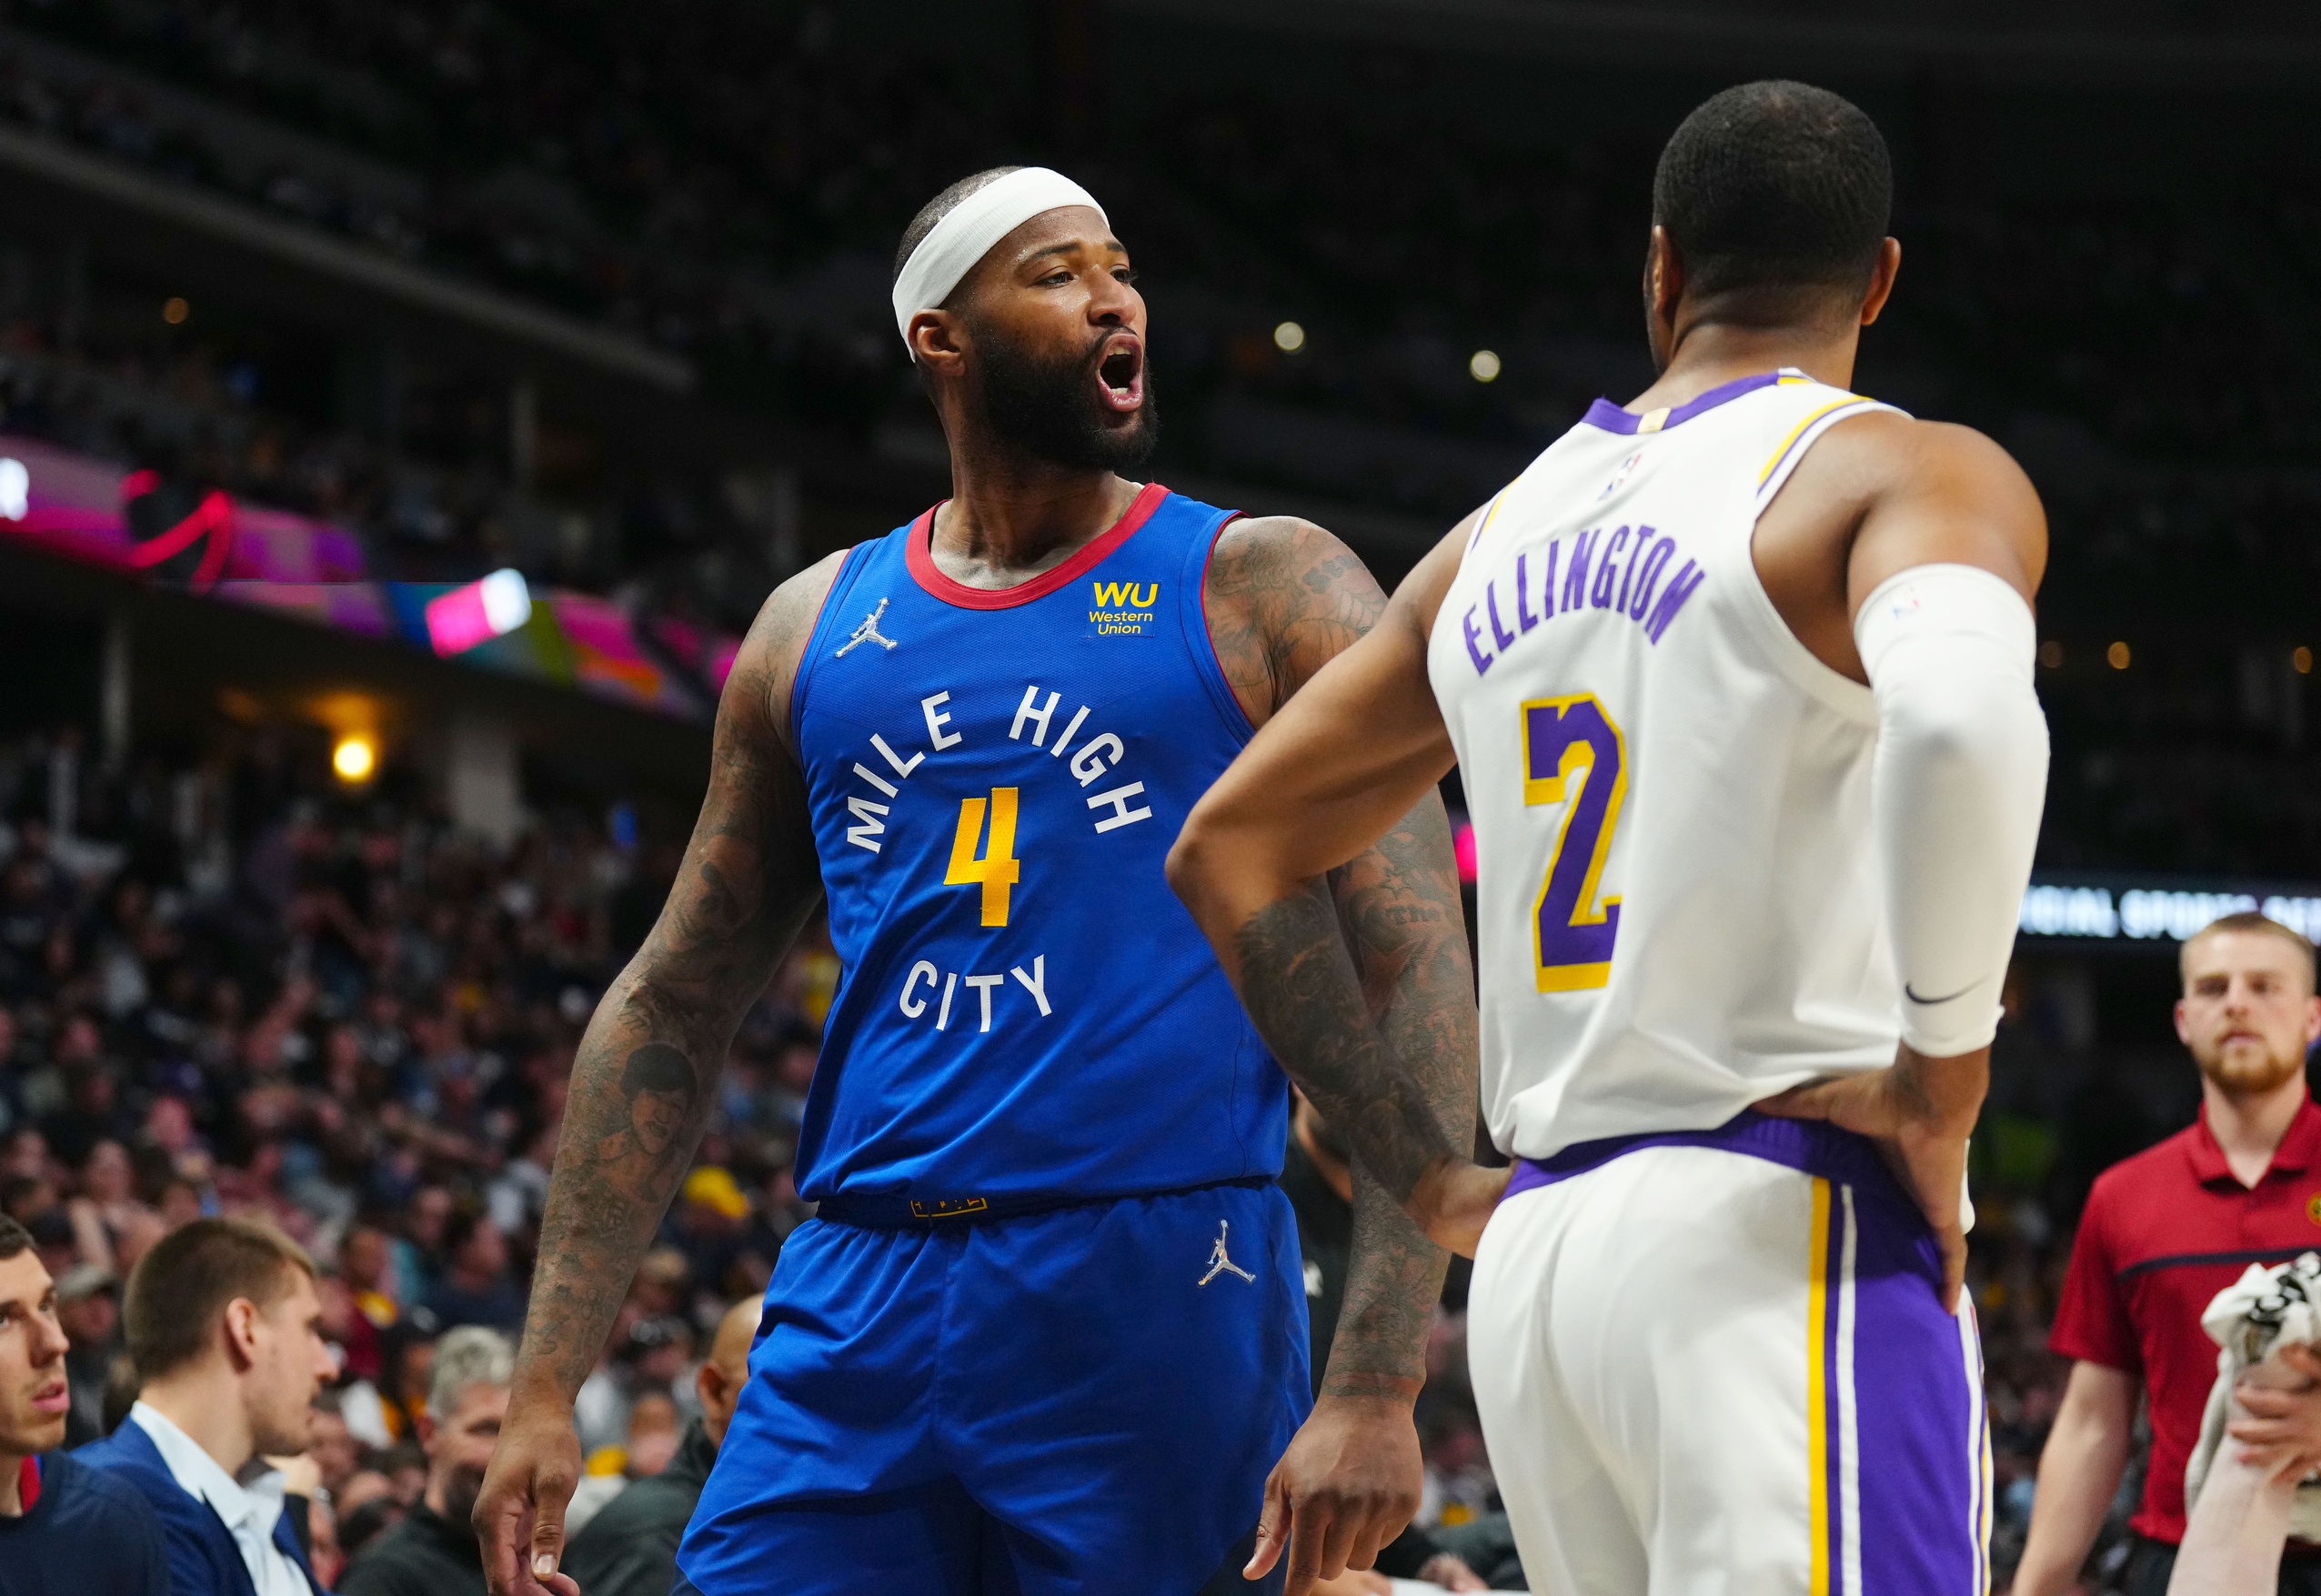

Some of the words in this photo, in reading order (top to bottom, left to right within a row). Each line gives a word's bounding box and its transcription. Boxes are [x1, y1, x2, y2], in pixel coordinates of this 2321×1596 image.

[1089, 611, 1153, 623] Western
[1093, 582, 1159, 607] WU
[1098, 622, 1141, 635] Union
[1462, 524, 1706, 677] ELLINGTON
[846, 690, 962, 854] MILE
[1008, 685, 1152, 835] HIGH
[943, 787, 1020, 927] 4
[1520, 692, 1626, 992] 2
[899, 954, 1052, 1033] CITY
